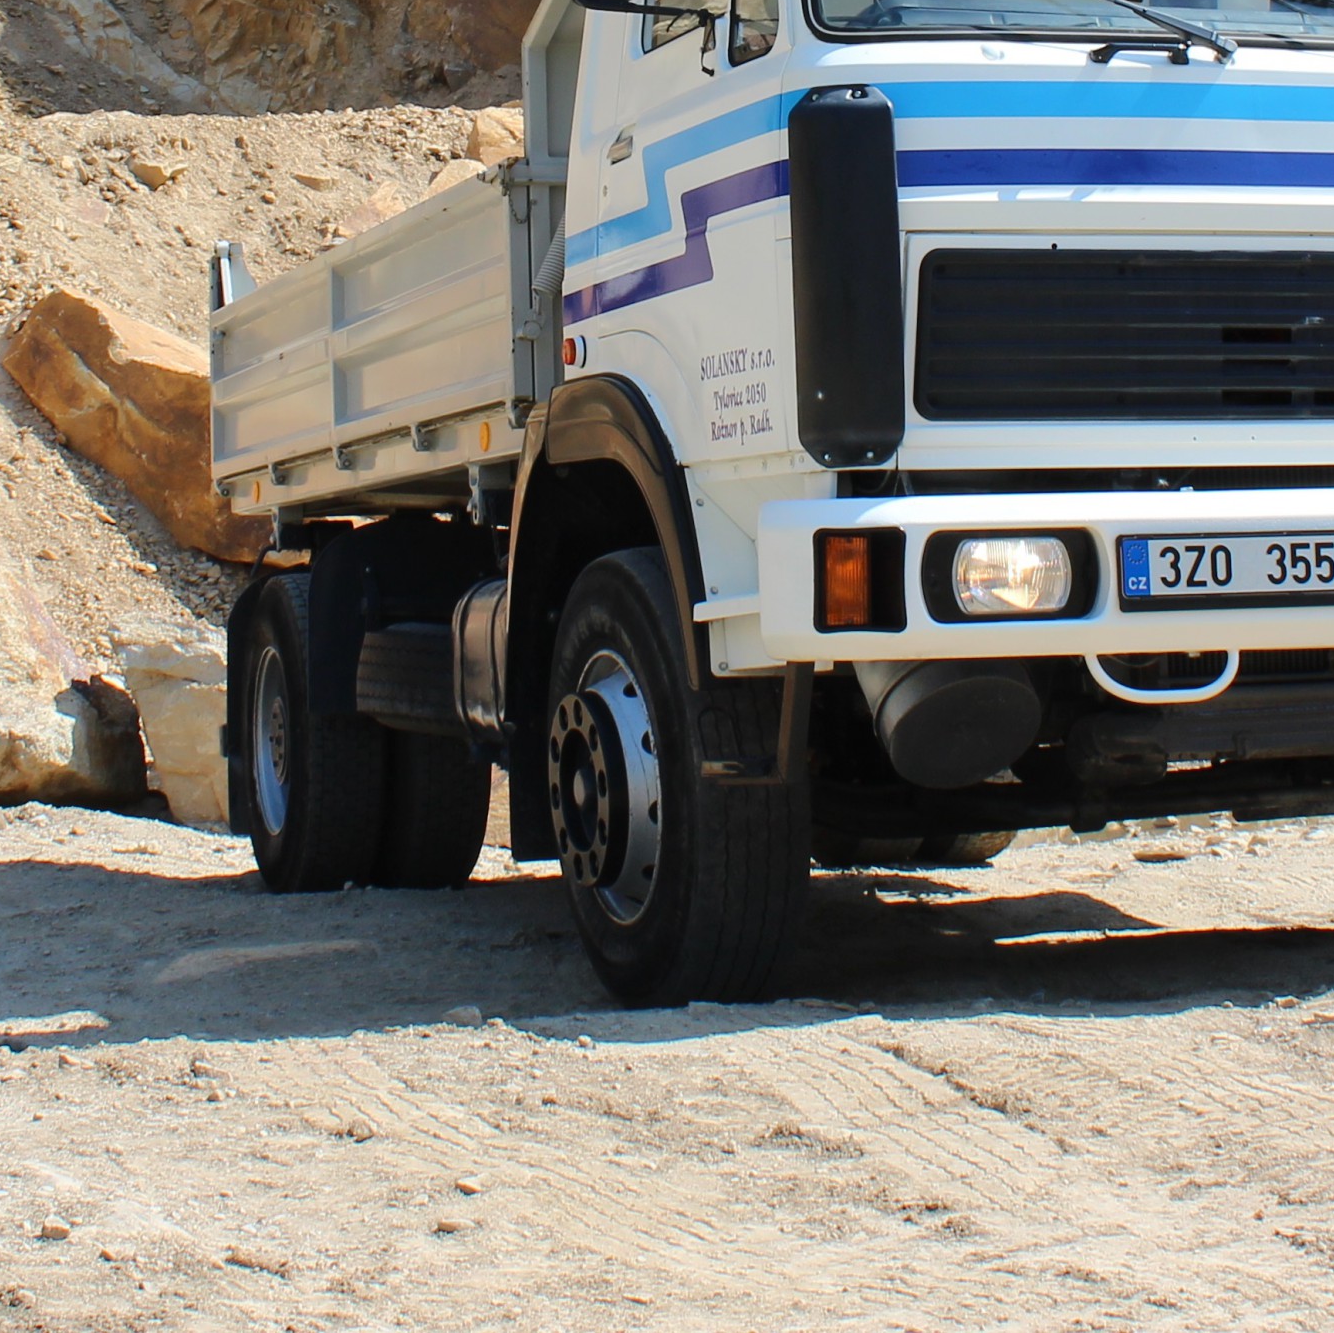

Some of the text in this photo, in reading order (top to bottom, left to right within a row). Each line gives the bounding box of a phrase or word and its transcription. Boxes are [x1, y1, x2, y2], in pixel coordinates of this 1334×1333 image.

[750, 348, 775, 370] s.r.o.
[746, 382, 766, 404] 2050
[739, 417, 748, 446] p.
[1128, 576, 1147, 590] CZ
